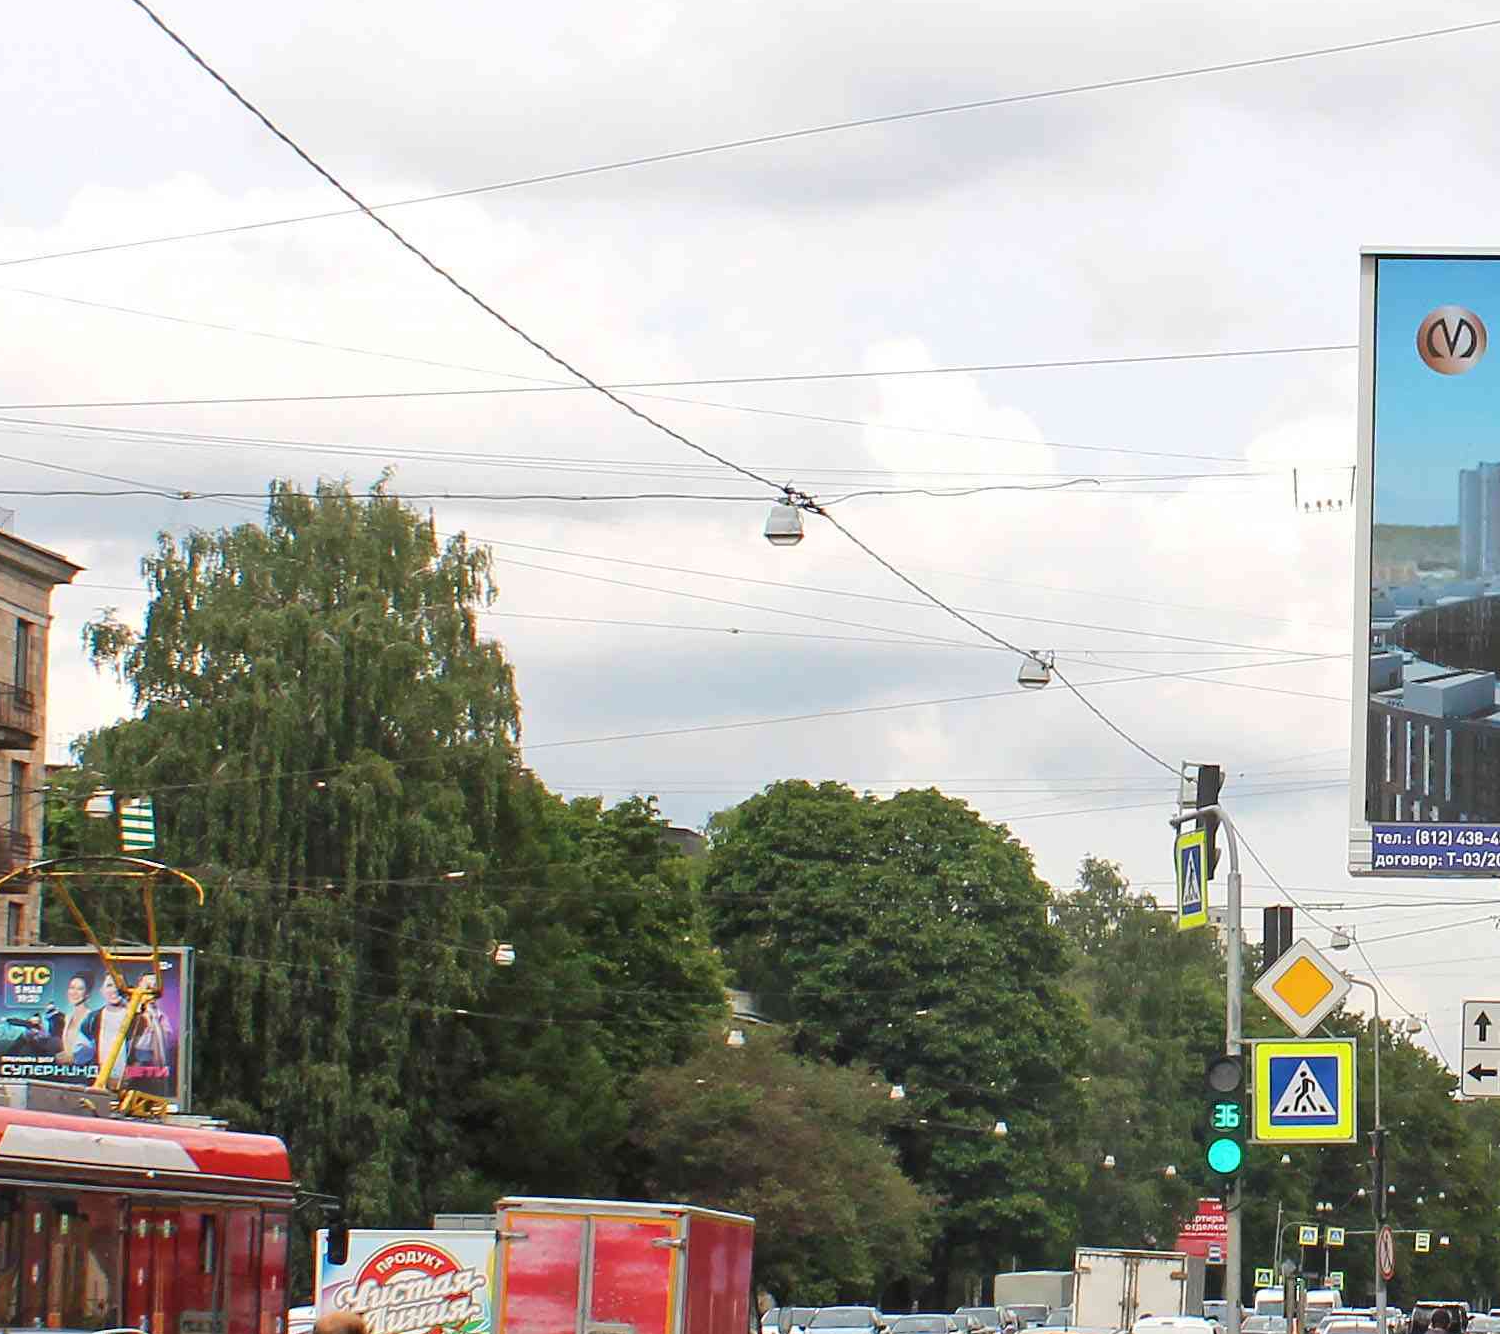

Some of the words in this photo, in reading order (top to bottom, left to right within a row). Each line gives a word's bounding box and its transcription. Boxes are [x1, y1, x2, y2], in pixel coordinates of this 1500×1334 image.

[1376, 832, 1411, 845] тел.:
[1415, 829, 1453, 846] (812)
[1375, 853, 1443, 869] договор:
[8, 966, 51, 985] СТС
[1, 1064, 101, 1077] СУПЕРНИНД
[1215, 1104, 1239, 1127] 36
[375, 1250, 445, 1274] ПРОДУКТ
